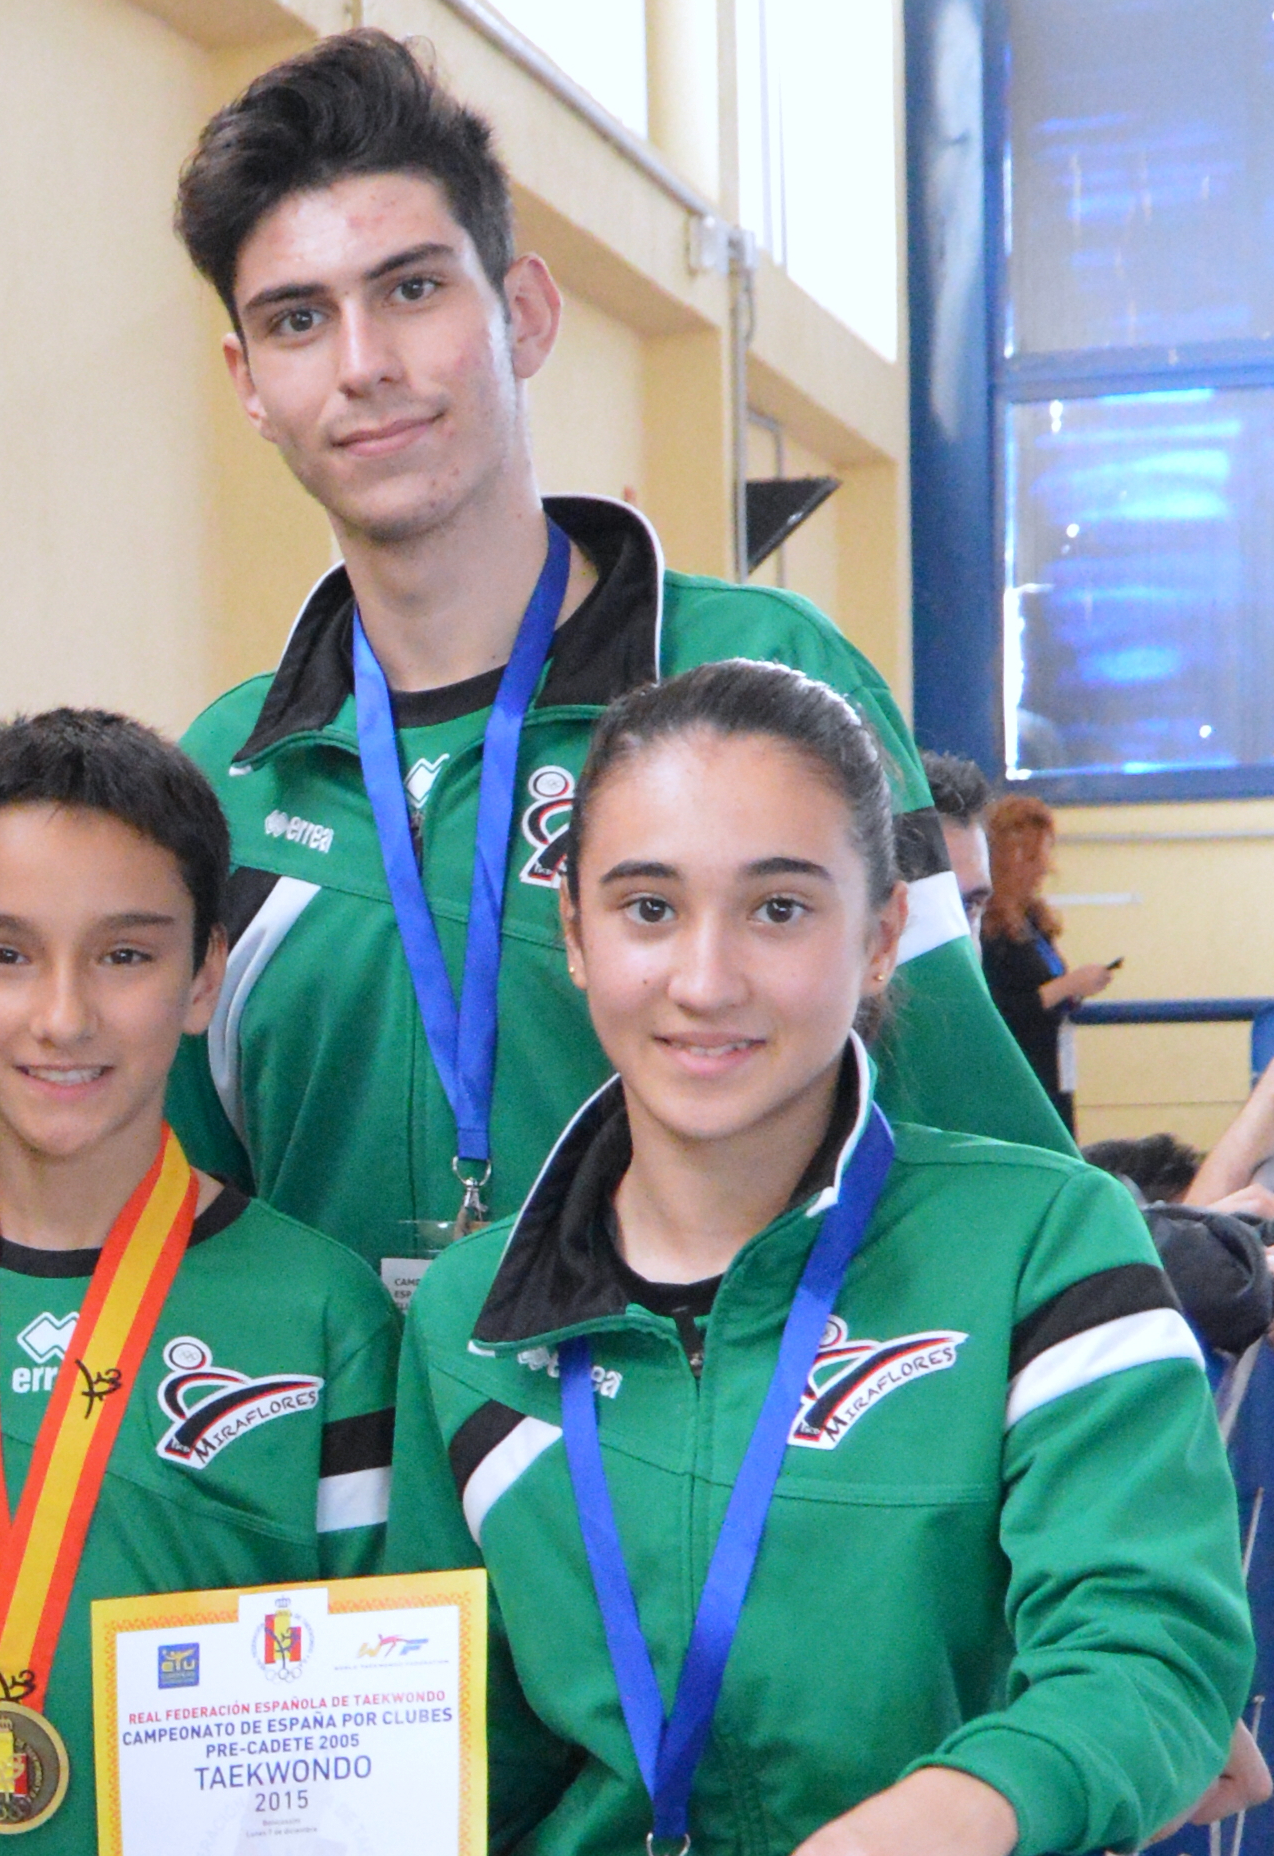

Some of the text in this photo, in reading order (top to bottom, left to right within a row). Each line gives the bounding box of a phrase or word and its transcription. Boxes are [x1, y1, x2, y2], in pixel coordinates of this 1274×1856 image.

[286, 816, 334, 853] errea
[824, 1346, 953, 1443] MIRAFLORES
[192, 1390, 318, 1465] MIRAFLORES
[129, 1690, 446, 1725] REAL FEDERACIÓN ESPAÑOLA DE TAEKWONDO
[122, 1707, 454, 1746] CAMPEONATO DE ESPAÑA POR CLUBES
[206, 1733, 360, 1759] PRE-CADETE 2005
[194, 1755, 372, 1791] TAEKWONDO
[255, 1789, 309, 1813] 2015
